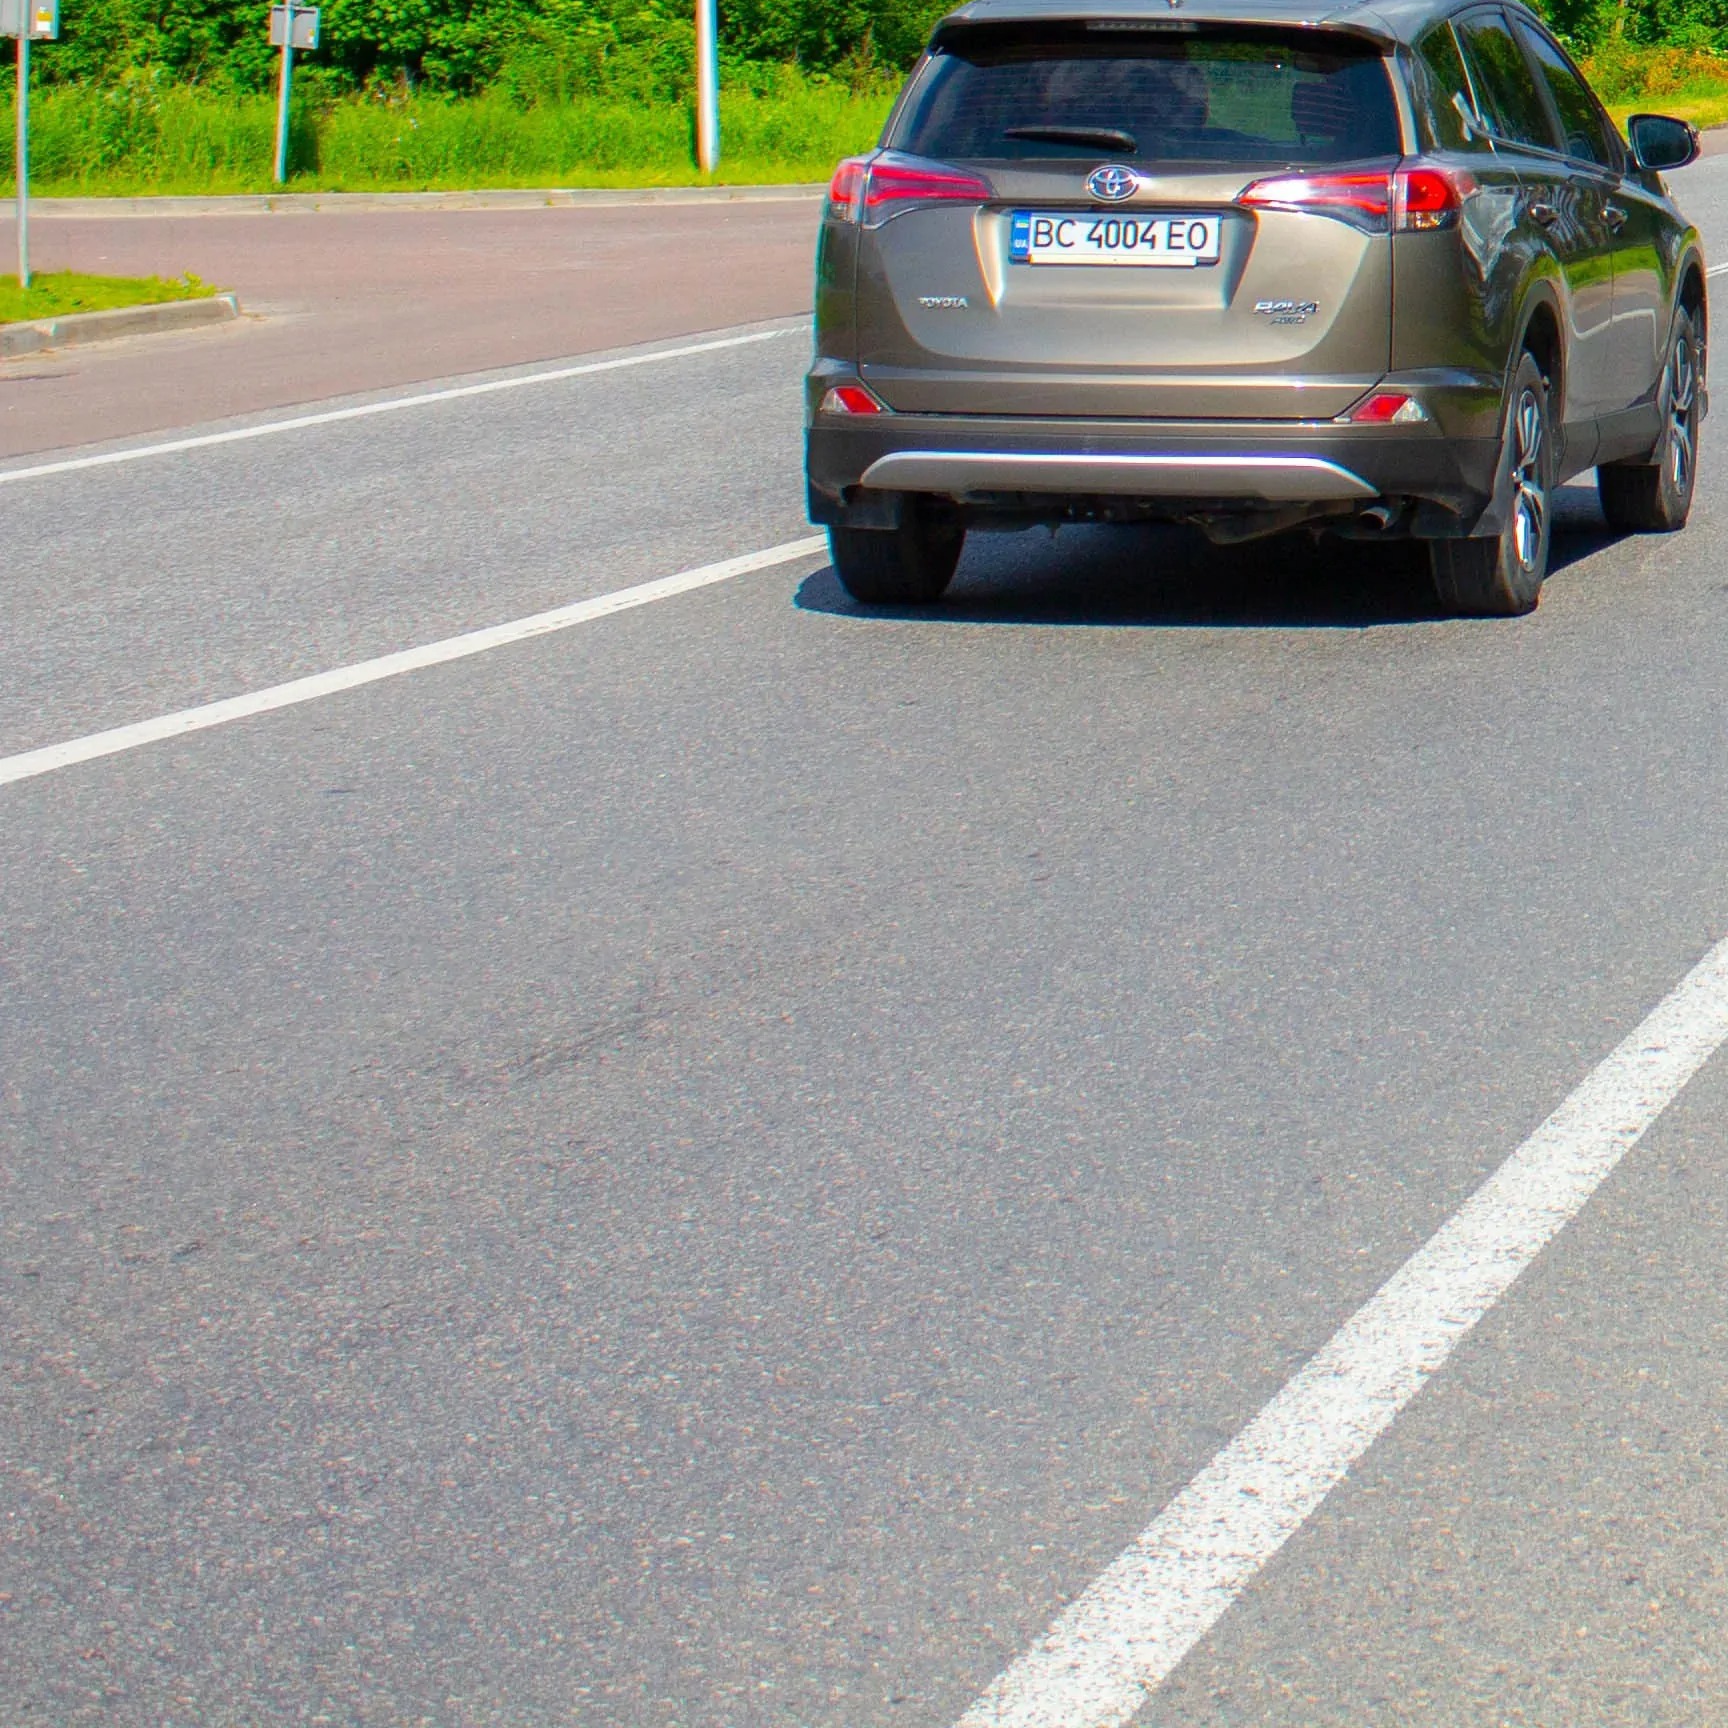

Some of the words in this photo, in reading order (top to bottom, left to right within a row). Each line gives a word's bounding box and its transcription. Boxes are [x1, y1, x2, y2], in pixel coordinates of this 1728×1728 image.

[1034, 219, 1077, 248] BC
[1086, 218, 1157, 250] 4004
[1167, 220, 1209, 250] EO
[1014, 238, 1029, 249] UA
[917, 296, 968, 309] TOYOTA
[1252, 300, 1319, 315] RAV4
